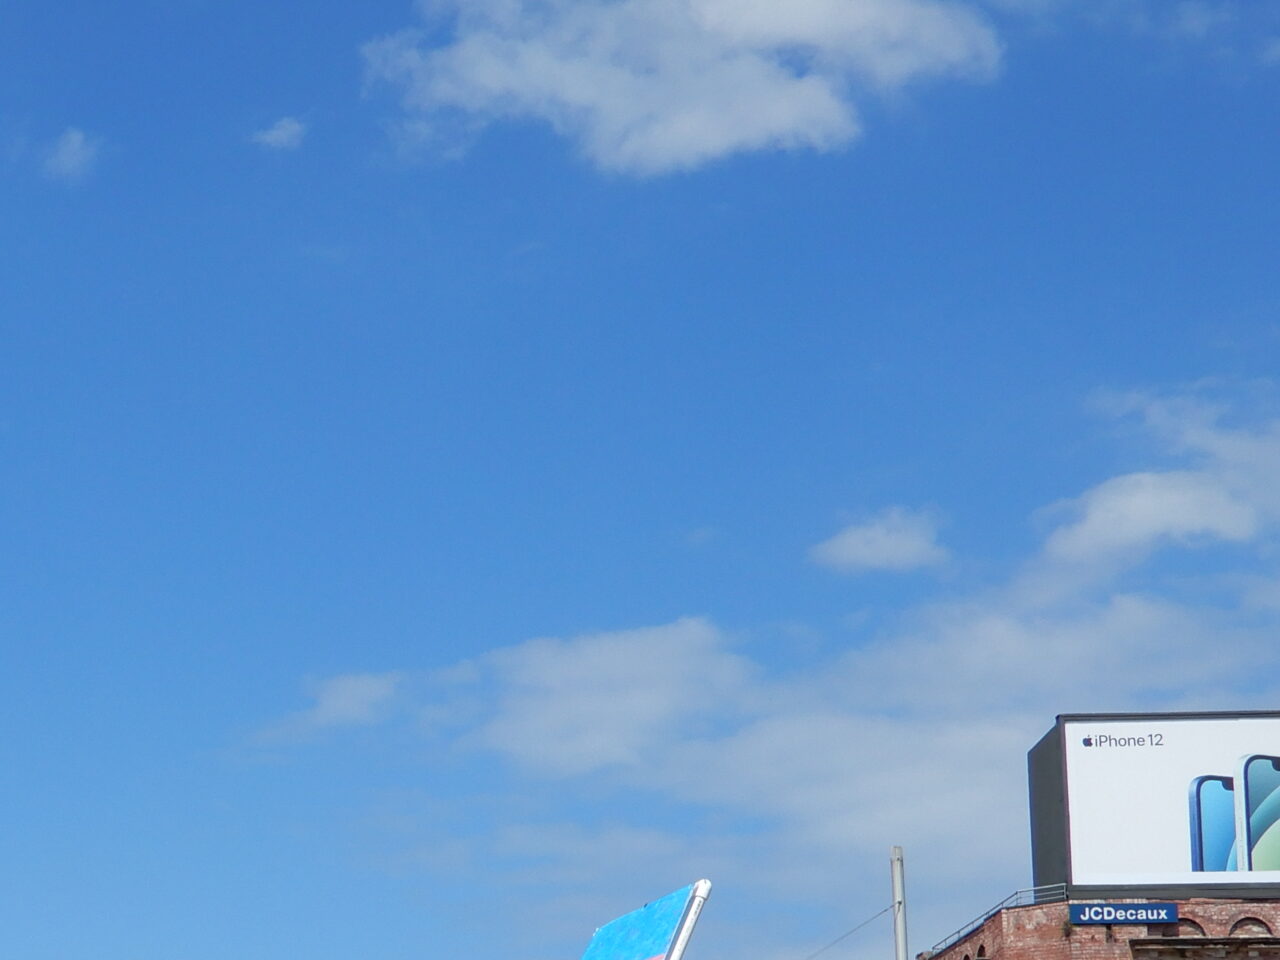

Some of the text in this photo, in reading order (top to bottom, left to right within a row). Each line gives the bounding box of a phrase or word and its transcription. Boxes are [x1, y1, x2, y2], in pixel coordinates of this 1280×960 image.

[1094, 733, 1164, 748] iPhone 12
[1080, 907, 1168, 921] JCDecaux
